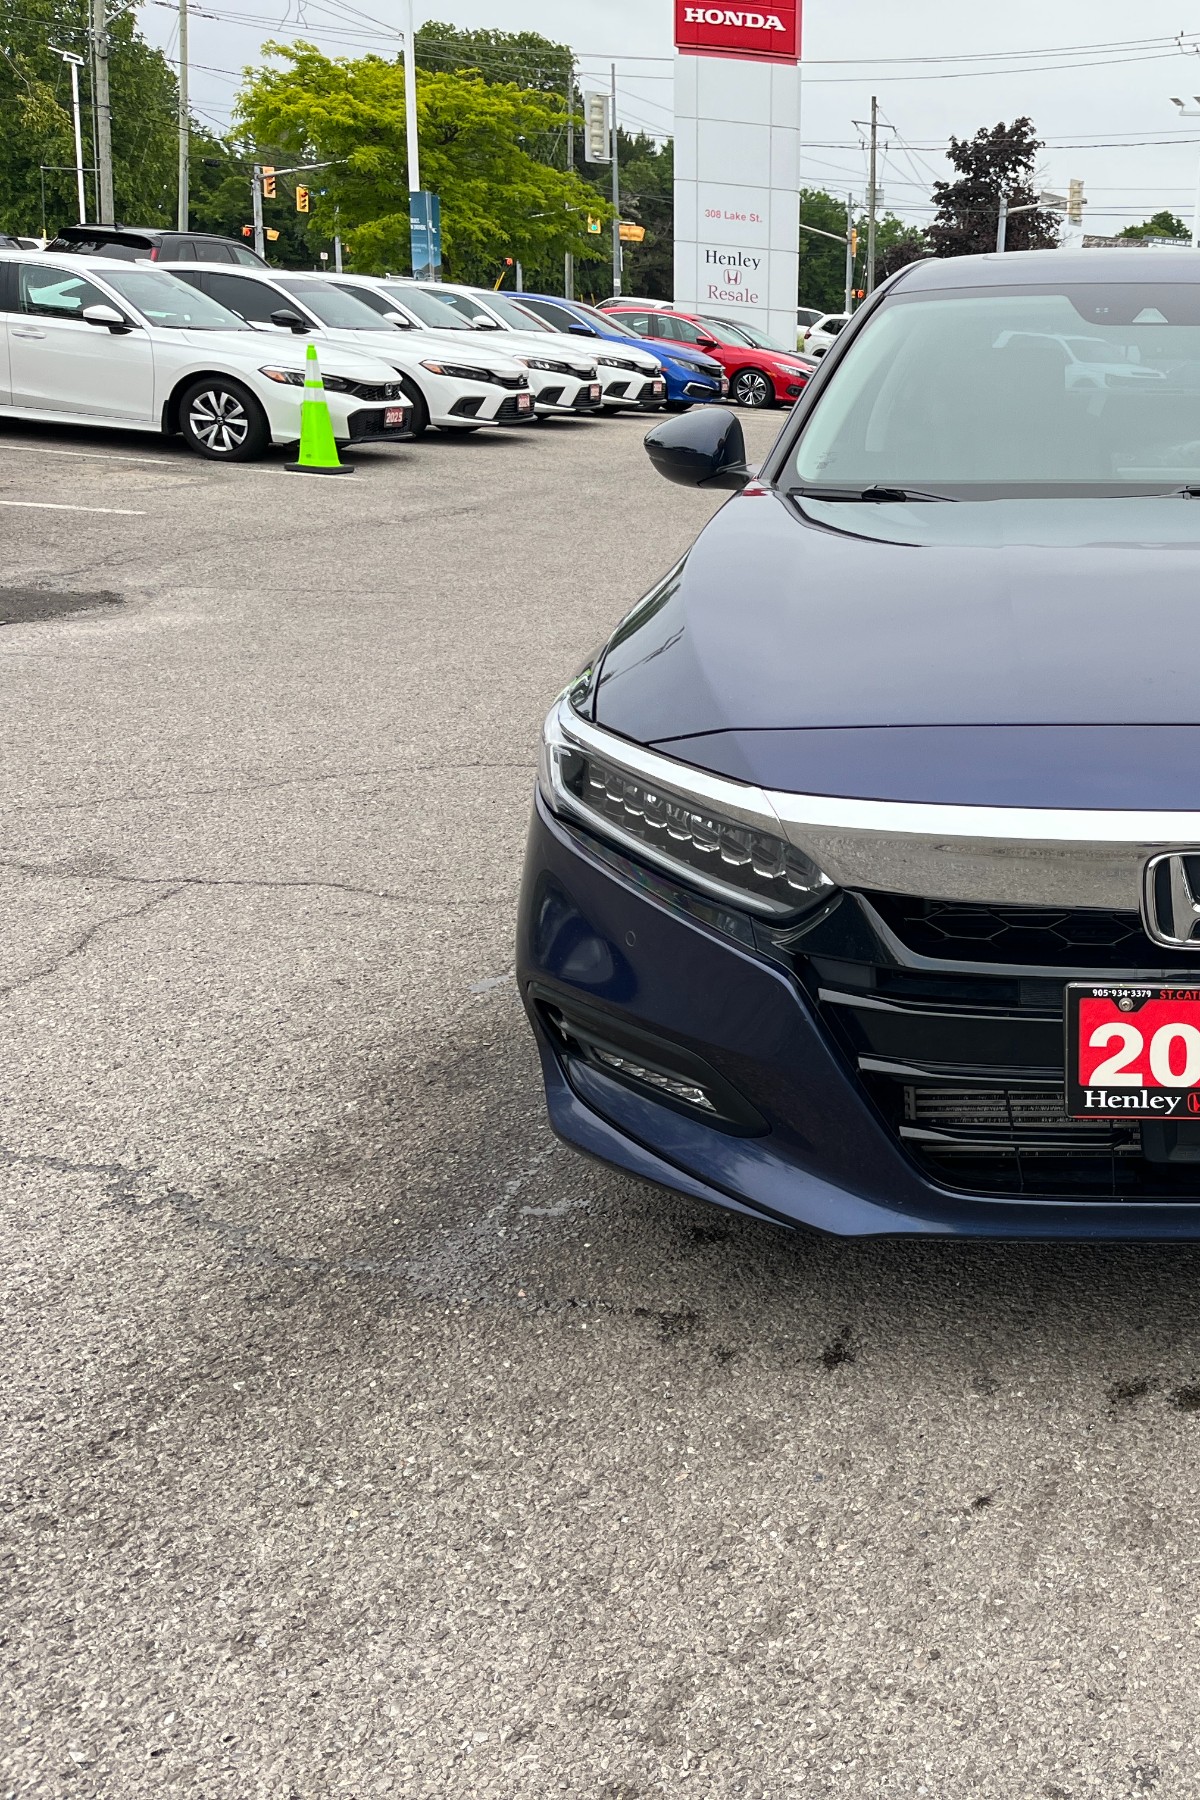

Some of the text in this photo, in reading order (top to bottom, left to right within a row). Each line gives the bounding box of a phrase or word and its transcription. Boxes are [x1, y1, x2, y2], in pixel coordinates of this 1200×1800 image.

[684, 7, 786, 31] HONDA
[704, 209, 763, 223] 308 Lake St.
[705, 249, 761, 270] Henley
[707, 284, 759, 304] Resale
[1092, 989, 1152, 998] 905-934-3379
[1084, 1090, 1181, 1115] Henley
